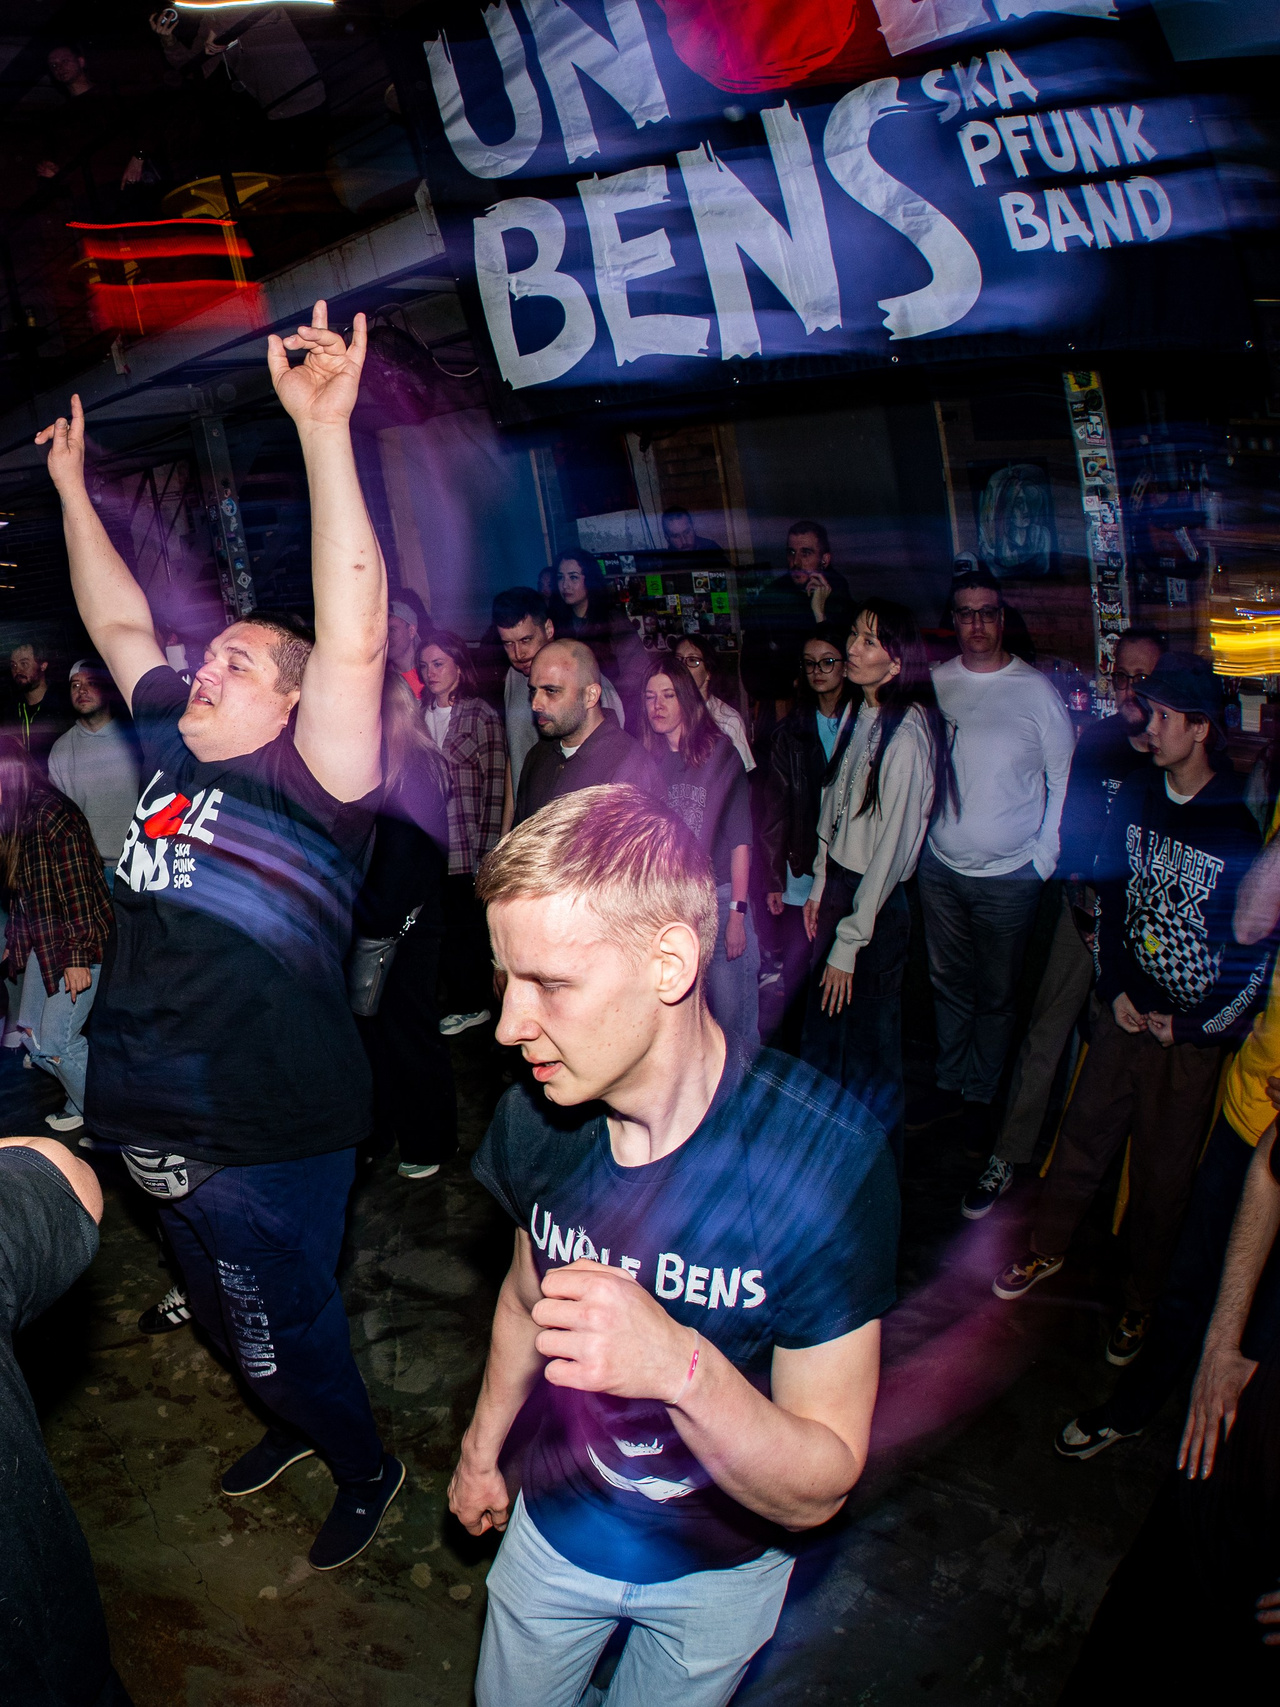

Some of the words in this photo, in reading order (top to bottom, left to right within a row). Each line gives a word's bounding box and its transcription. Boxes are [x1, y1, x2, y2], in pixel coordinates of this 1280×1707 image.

[921, 49, 1039, 123] SKA
[957, 104, 1158, 187] PFUNK
[473, 76, 983, 390] BENS
[998, 175, 1173, 253] BAND
[172, 857, 197, 874] PUNK
[173, 873, 193, 889] SPB
[174, 843, 192, 857] SKA
[654, 1252, 767, 1310] BENS
